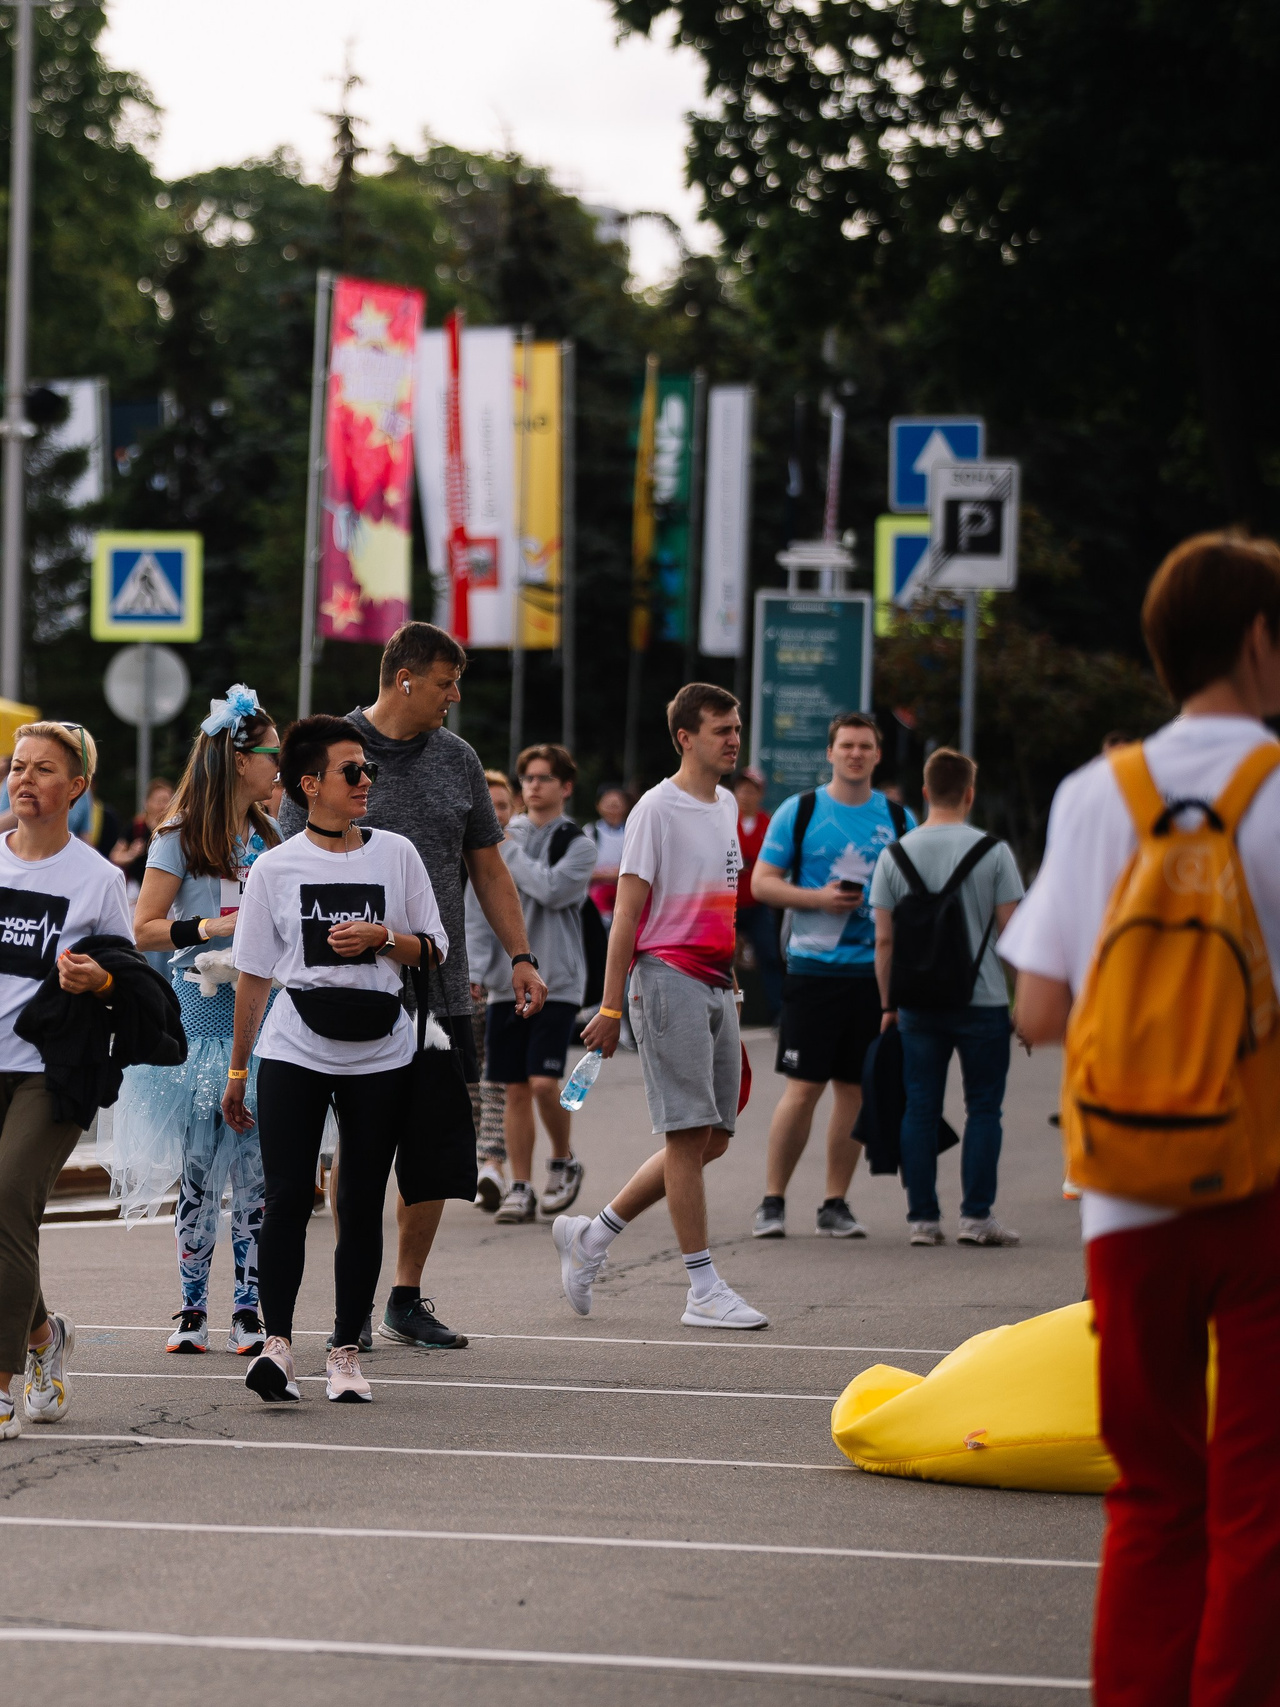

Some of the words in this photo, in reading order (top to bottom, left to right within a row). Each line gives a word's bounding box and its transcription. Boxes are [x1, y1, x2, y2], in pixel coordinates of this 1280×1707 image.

[959, 502, 992, 551] P
[726, 851, 737, 890] ЗАБЕГ
[1, 929, 36, 947] RUN
